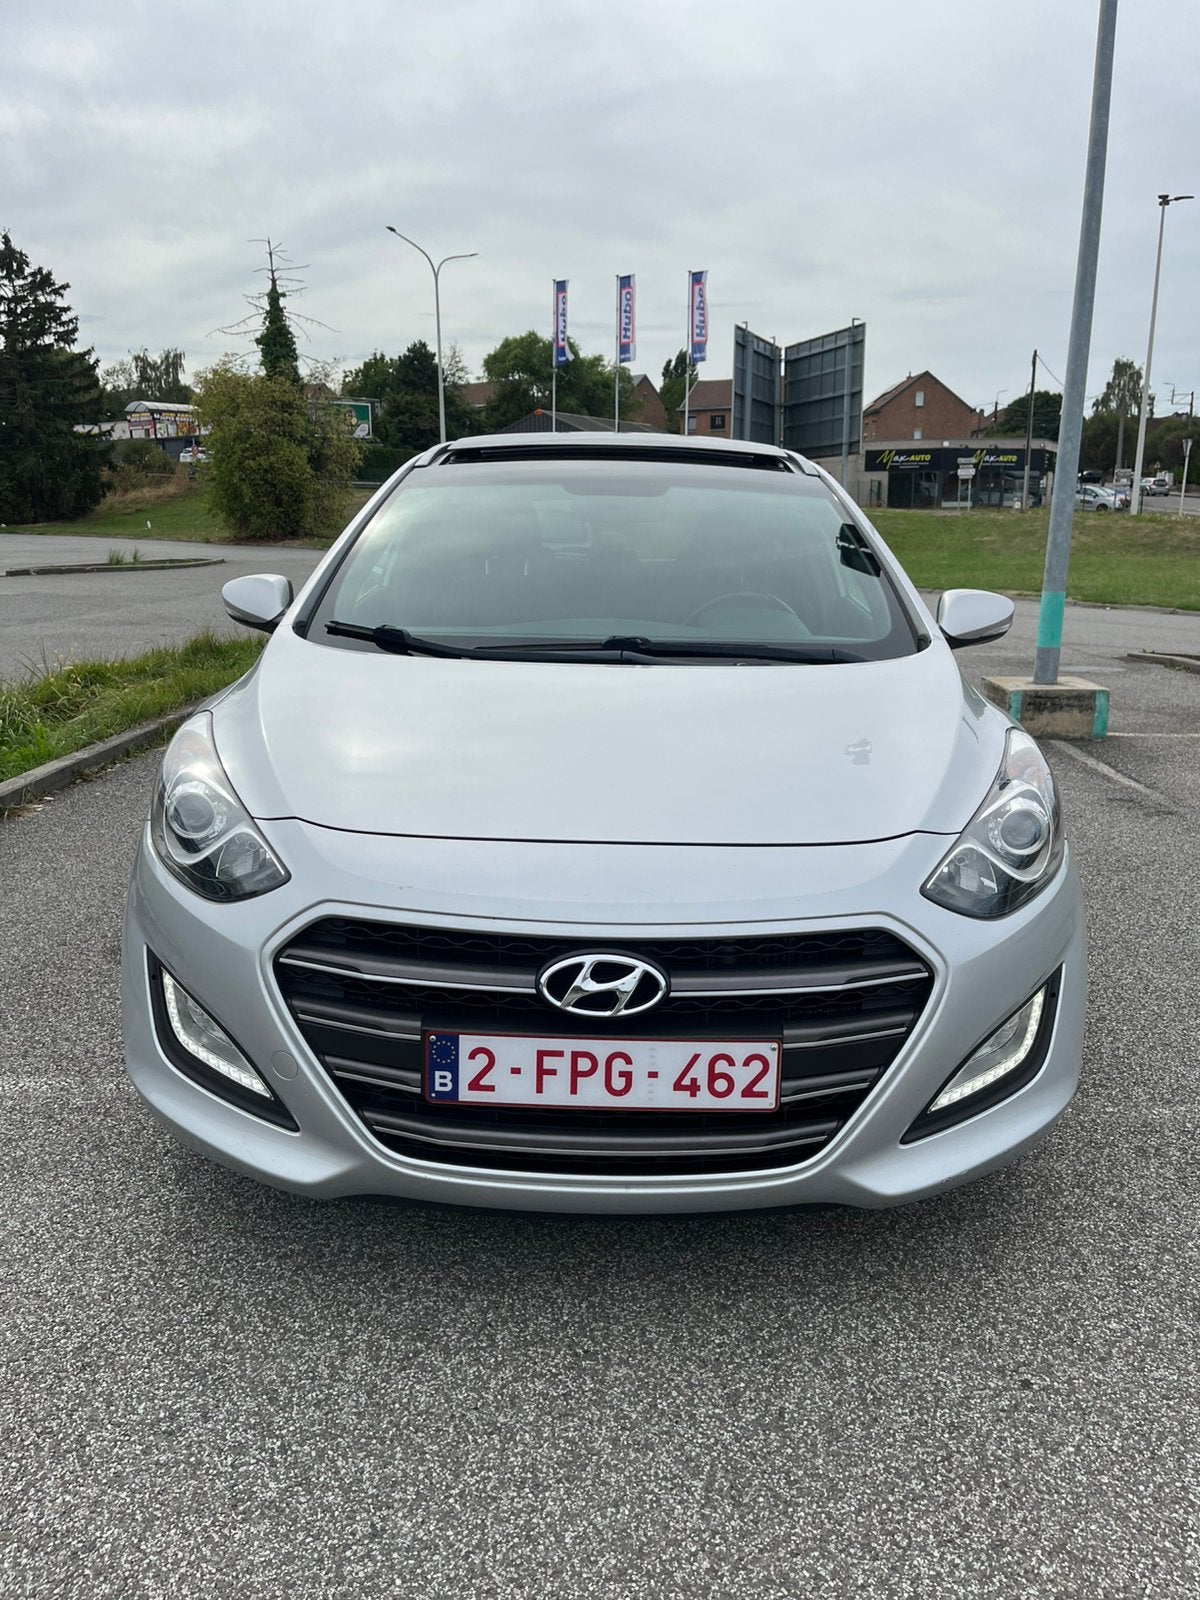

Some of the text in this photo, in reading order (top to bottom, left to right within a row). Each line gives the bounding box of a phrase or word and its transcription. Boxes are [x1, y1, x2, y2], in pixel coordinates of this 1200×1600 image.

[622, 290, 632, 340] Hubo
[695, 286, 705, 338] Hubo
[909, 454, 932, 462] AUTO
[998, 454, 1018, 463] AUTO
[434, 1070, 453, 1092] B
[467, 1046, 771, 1099] 2-FPG-462
